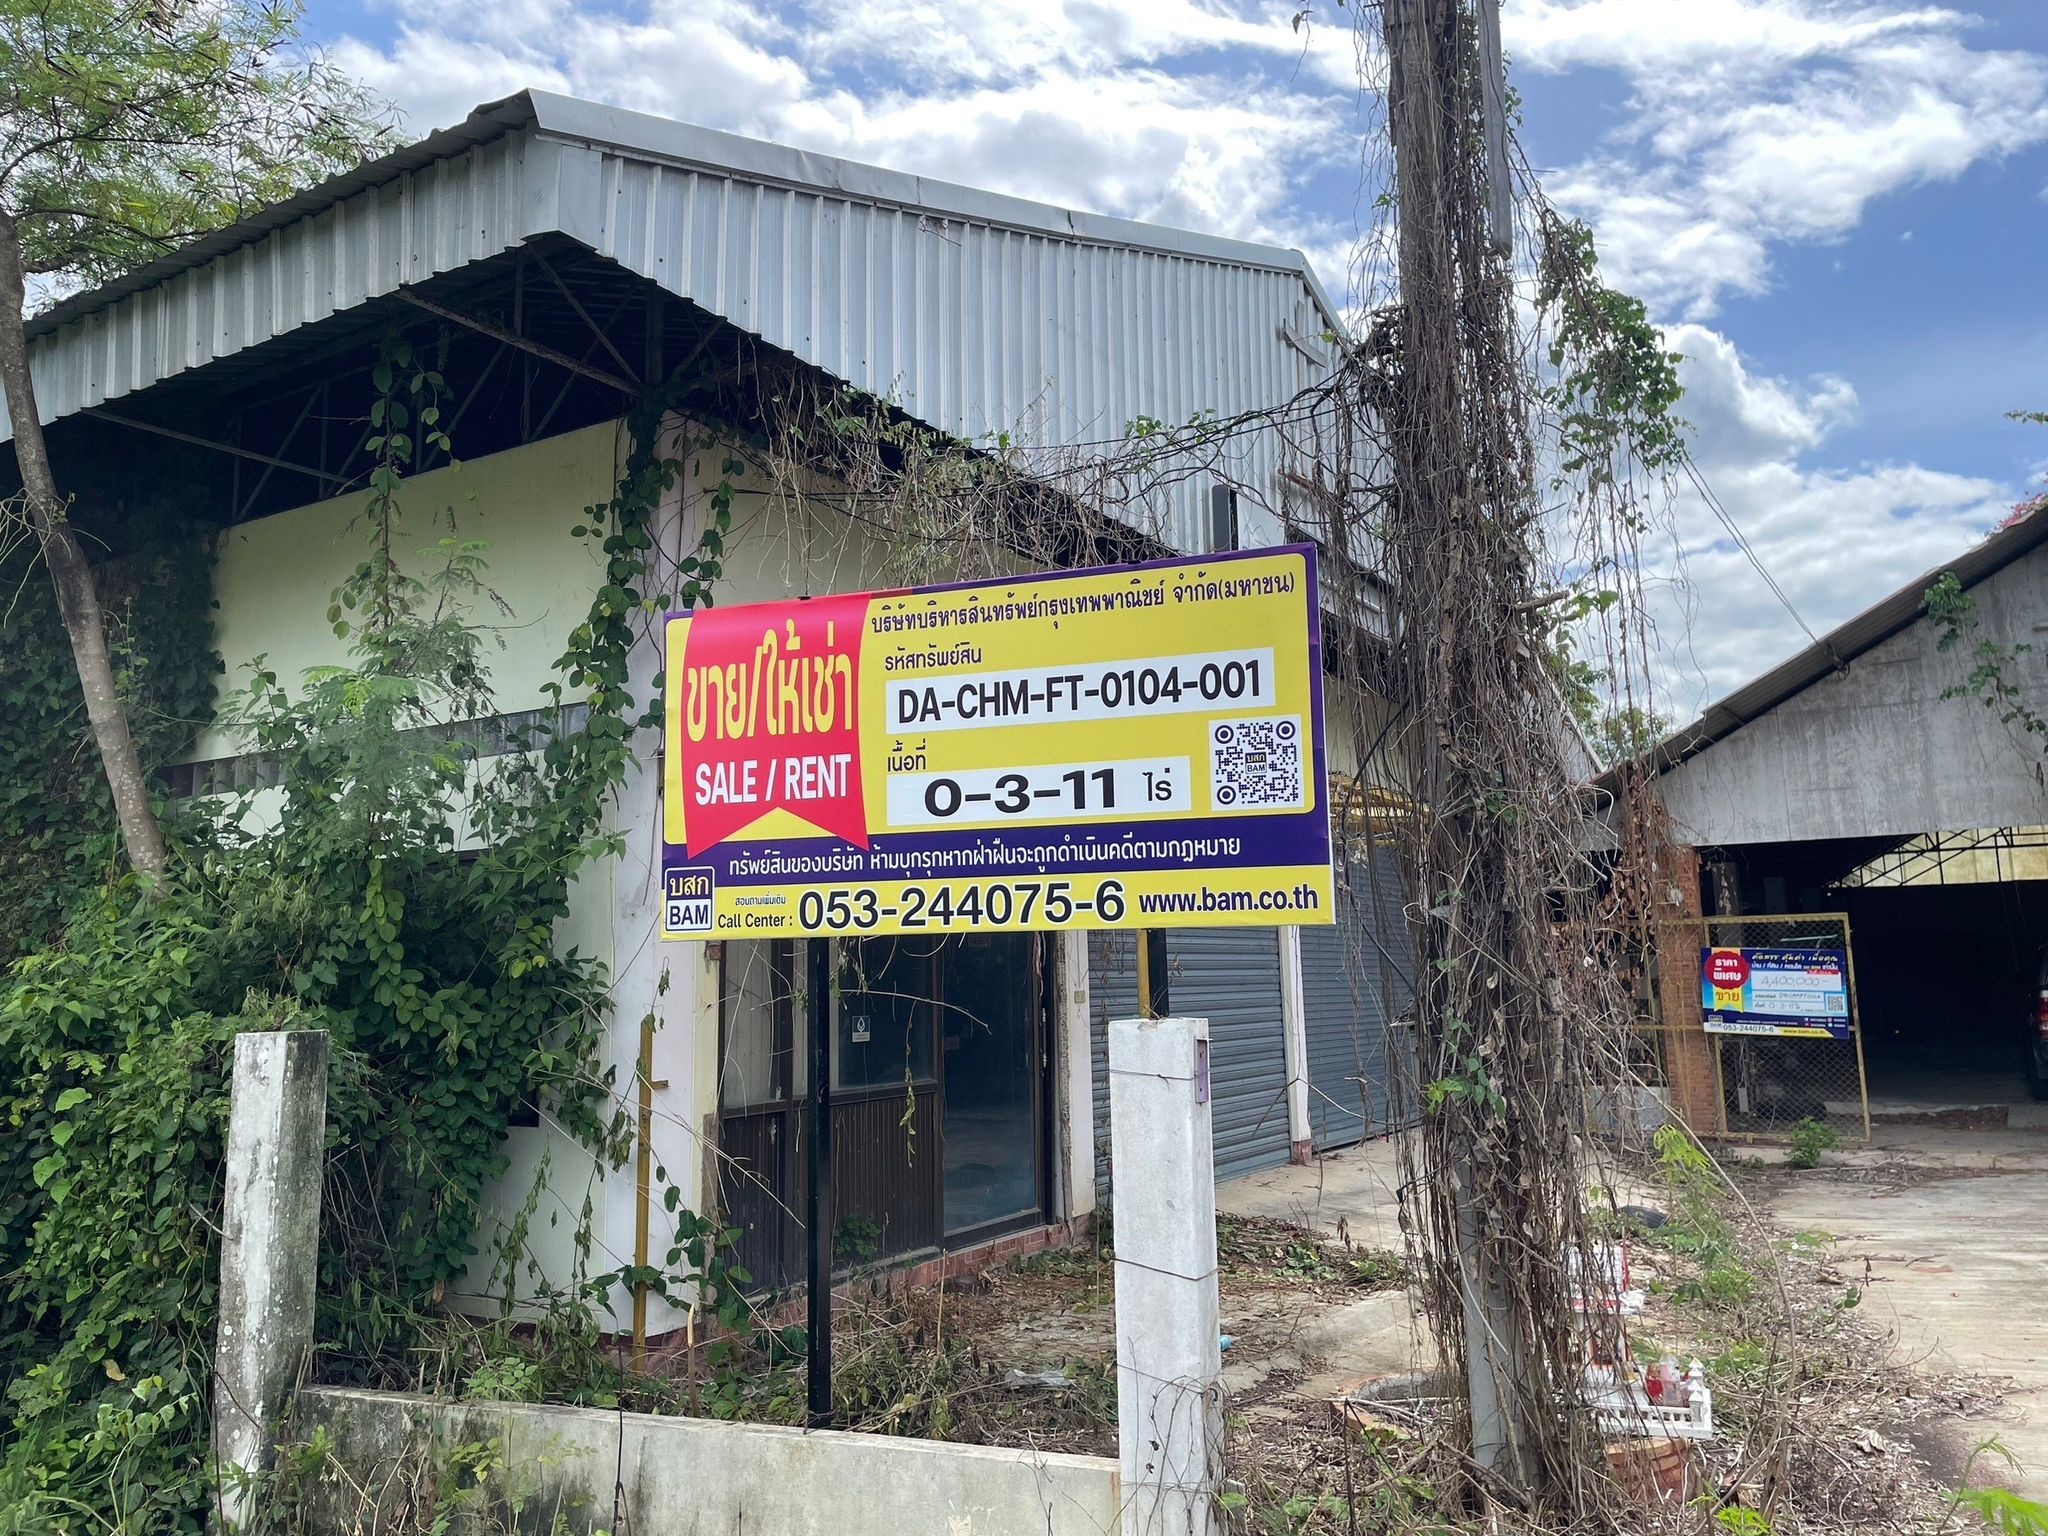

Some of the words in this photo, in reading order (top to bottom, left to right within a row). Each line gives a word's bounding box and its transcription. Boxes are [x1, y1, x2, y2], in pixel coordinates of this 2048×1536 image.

[884, 641, 982, 672] รหัสทรัพย์สิน
[686, 618, 853, 743] ขาย/ให้เช่า
[898, 659, 1260, 724] DA-CHM-FT-0104-001
[887, 738, 926, 773] เนื้อที่
[1247, 764, 1265, 772] BAM
[695, 758, 758, 807] SALE
[764, 758, 778, 802] /
[785, 753, 852, 801] RENT
[1142, 767, 1172, 802] ไร่
[729, 846, 863, 876] ทรัพย์สินของบริษัท
[669, 875, 709, 897] บสก
[669, 904, 708, 926] BAM
[718, 913, 741, 928] Call
[745, 913, 785, 928] Center
[800, 880, 1125, 930] 053-244075-6
[1138, 884, 1318, 913] www.bam.co.th
[1715, 991, 1740, 1002] ขาย
